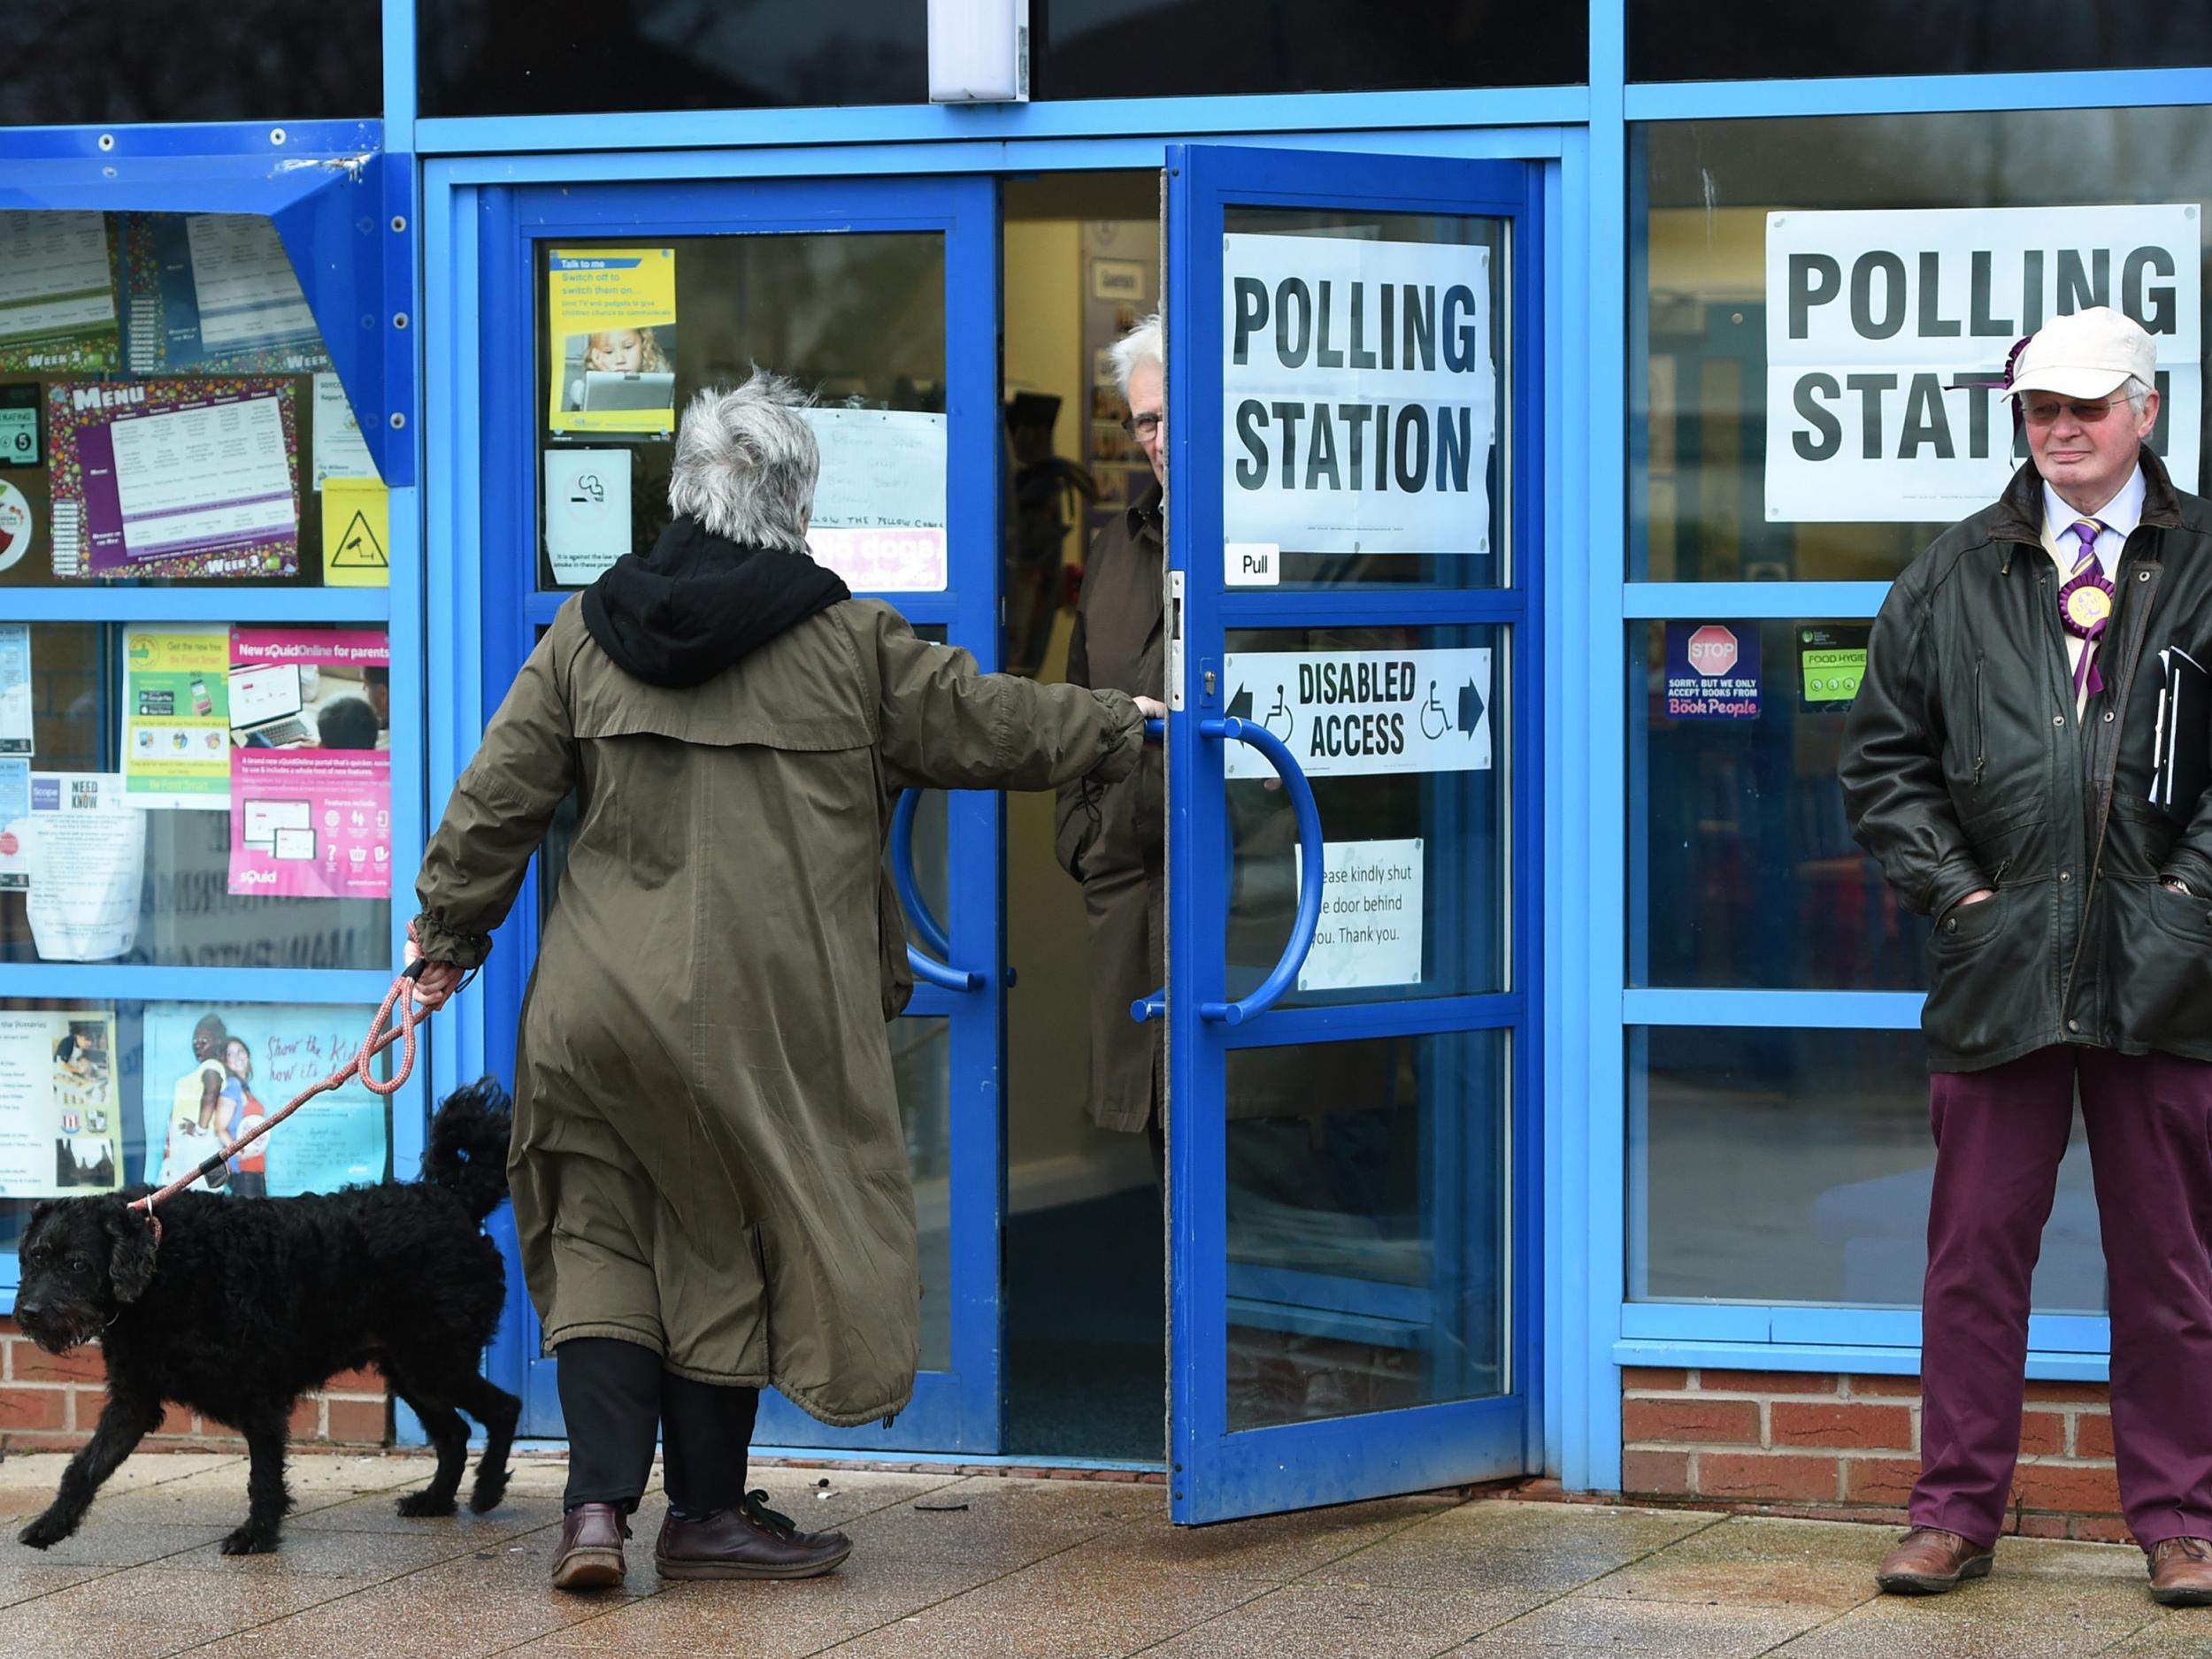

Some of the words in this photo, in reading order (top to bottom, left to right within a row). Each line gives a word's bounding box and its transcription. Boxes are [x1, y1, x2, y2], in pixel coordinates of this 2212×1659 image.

[561, 259, 579, 269] Talk
[580, 260, 590, 269] to
[562, 273, 593, 282] Switch
[562, 287, 592, 296] switch
[595, 286, 618, 295] them
[1788, 246, 2176, 340] POLLING
[1233, 276, 1476, 373] POLLING
[1791, 371, 2170, 462] STAT
[19, 434, 27, 449] 5
[1235, 399, 1471, 494] STATION
[861, 534, 935, 565] dogs
[250, 554, 259, 567] 3
[1242, 555, 1268, 575] Pull
[239, 644, 265, 657] New
[334, 645, 349, 657] for
[350, 647, 389, 659] parents
[1691, 642, 1734, 657] STOP
[1809, 655, 1837, 664] FOOD
[1839, 653, 1866, 663] HYGIE
[1298, 661, 1417, 705] DISABLED
[1669, 679, 1699, 688] SORRY,
[1701, 679, 1718, 687] BUT
[1720, 679, 1733, 687] WE
[1735, 679, 1756, 687] ONLY
[1668, 688, 1700, 697] ACCEPT
[1701, 688, 1732, 697] BOOKS
[1732, 688, 1758, 697] FROM
[1669, 698, 1708, 714] Book
[1708, 698, 1757, 718] People
[1310, 712, 1405, 757] ACCESS
[72, 780, 98, 793] NEED
[72, 795, 97, 809] KNOW
[241, 870, 277, 885] sQuid
[1323, 870, 1348, 884] ease
[1351, 865, 1384, 885] kindly
[1387, 864, 1411, 880] shut
[1333, 896, 1360, 913] door
[1363, 895, 1402, 911] behind
[1339, 926, 1373, 943] Thank
[1376, 928, 1400, 946] you.
[266, 1036, 303, 1060] Show
[306, 1034, 321, 1059] the
[328, 1033, 358, 1061] Kid
[269, 1061, 297, 1081] how
